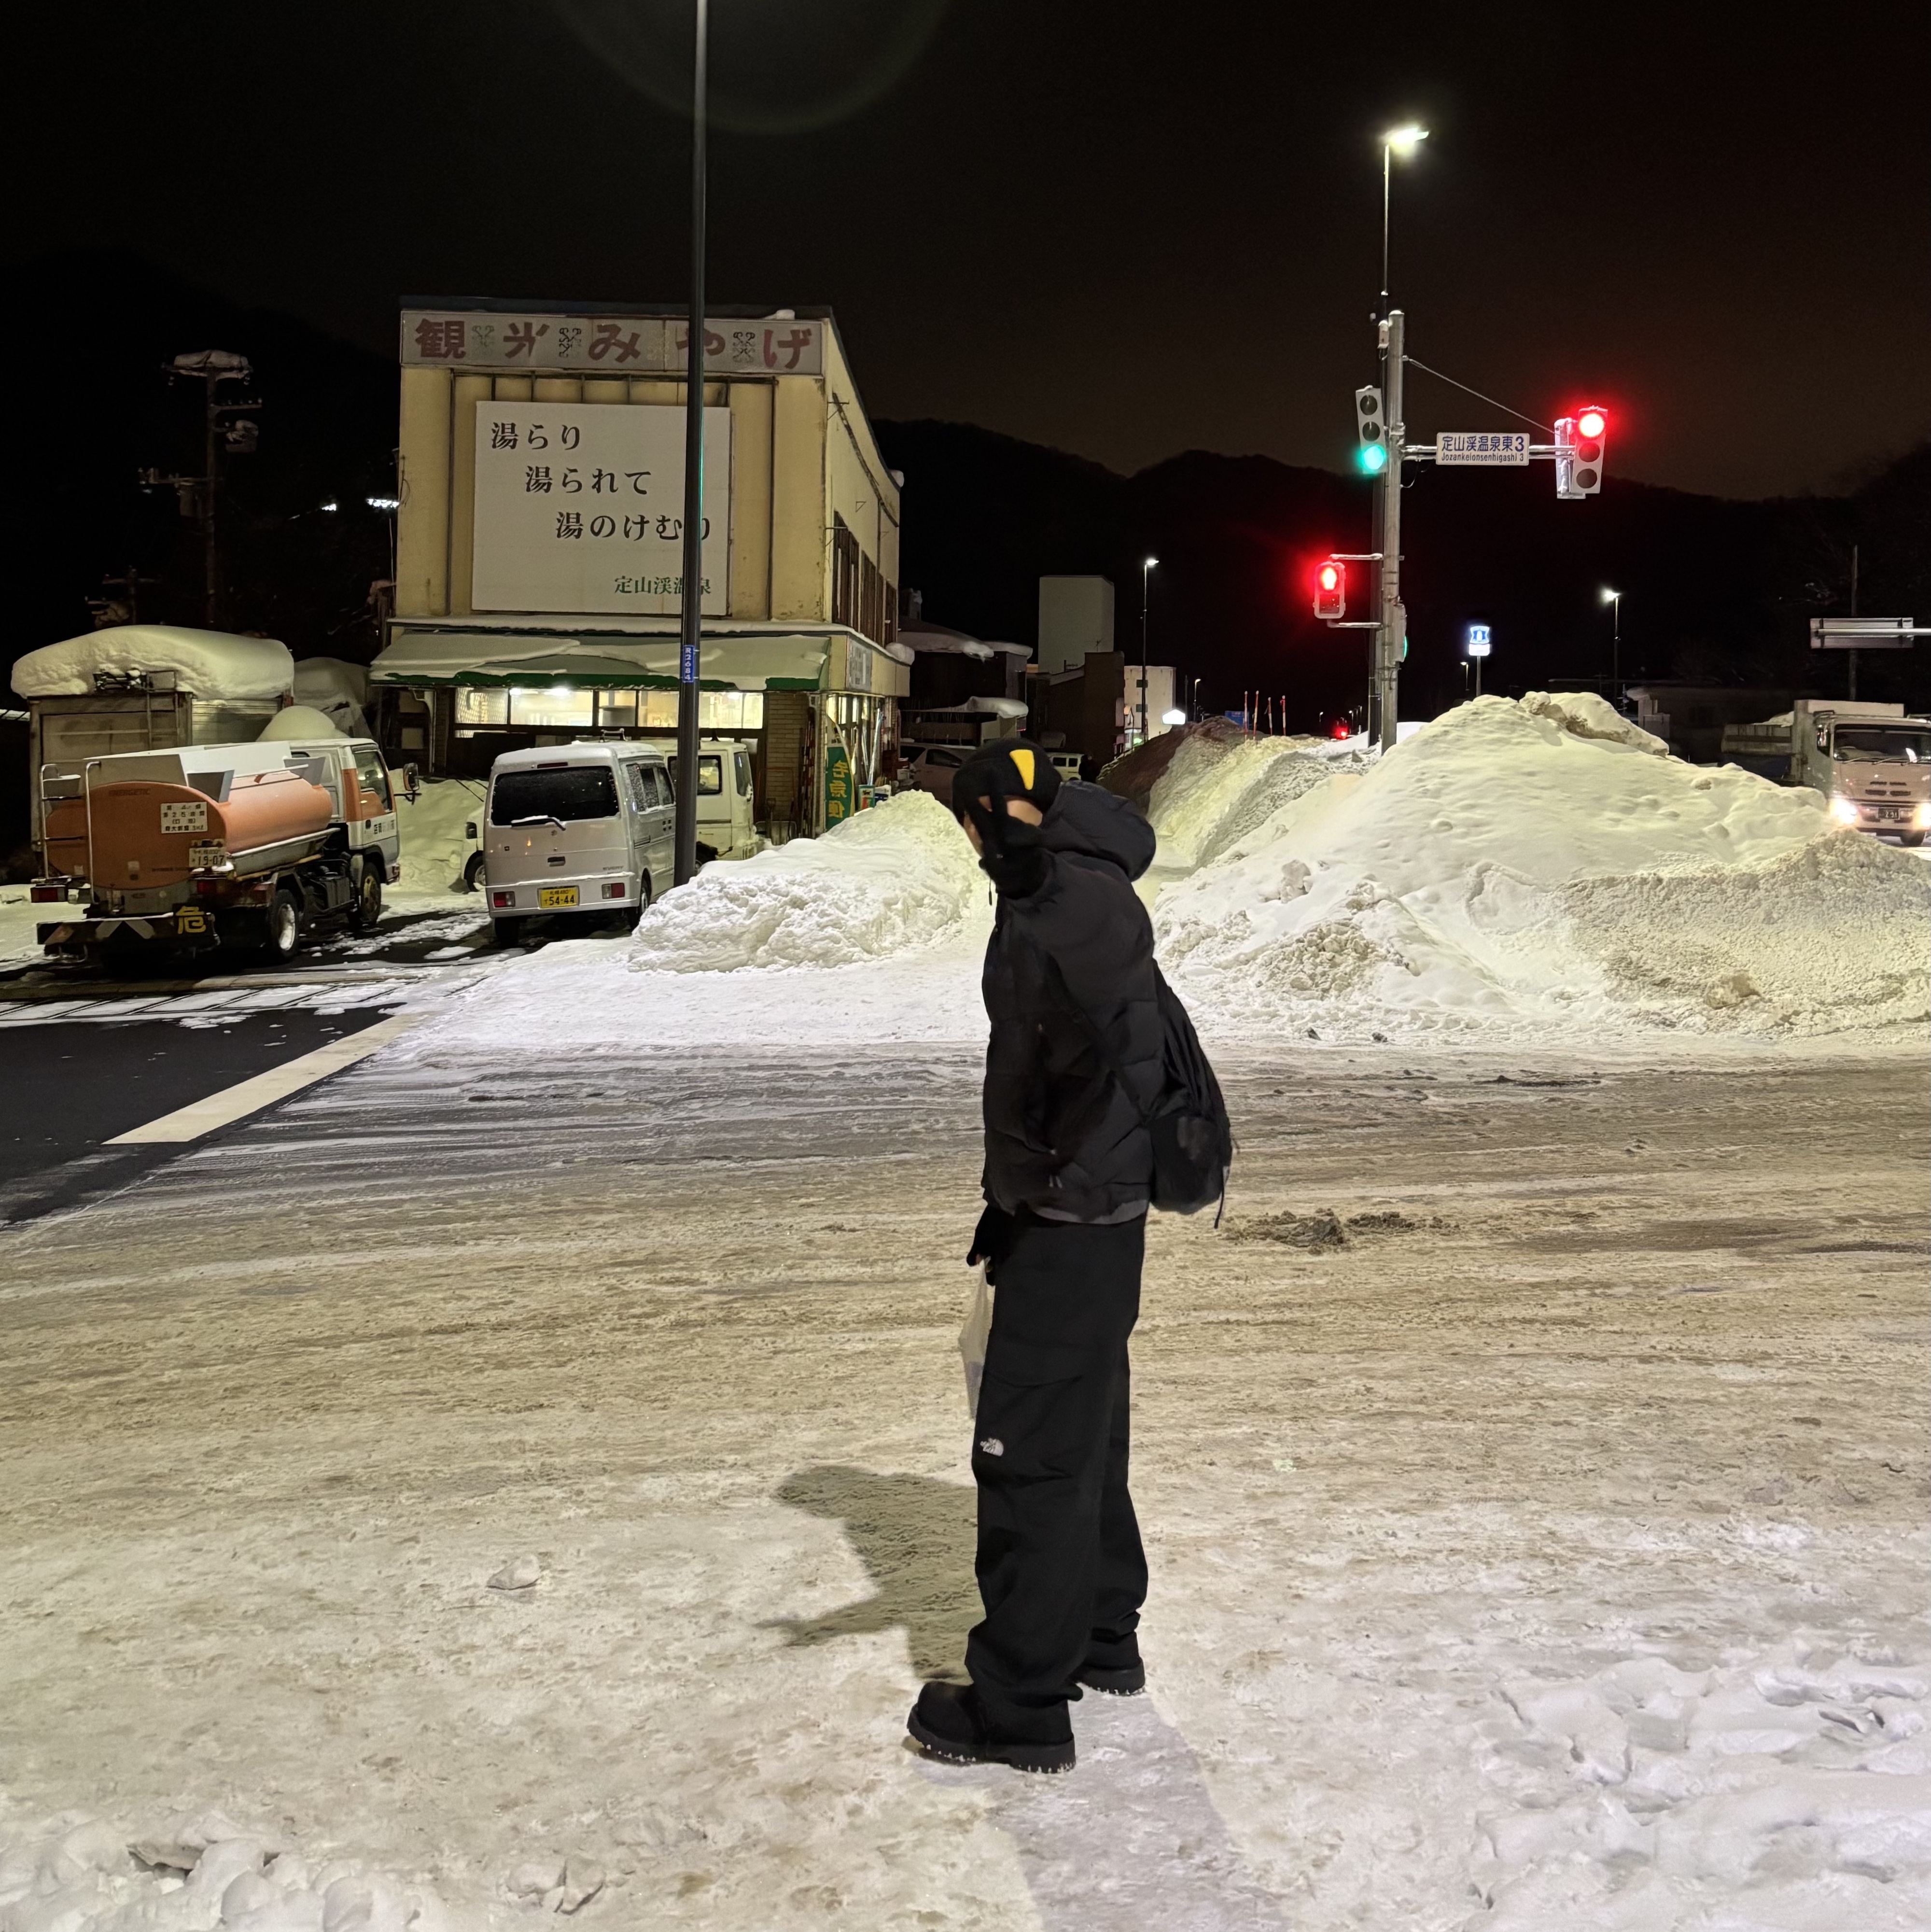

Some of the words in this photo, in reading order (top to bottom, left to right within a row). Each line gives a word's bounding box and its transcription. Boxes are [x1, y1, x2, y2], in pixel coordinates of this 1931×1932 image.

[491, 421, 580, 450] 湯らり
[1442, 435, 1525, 452] 定山渓温泉東3
[1441, 452, 1517, 462] Jozankeionsenhigashi
[1519, 453, 1524, 462] 3
[526, 466, 651, 495] 湯られて
[198, 855, 224, 866] 19-07
[549, 895, 574, 905] 54-44
[176, 906, 206, 934] 危
